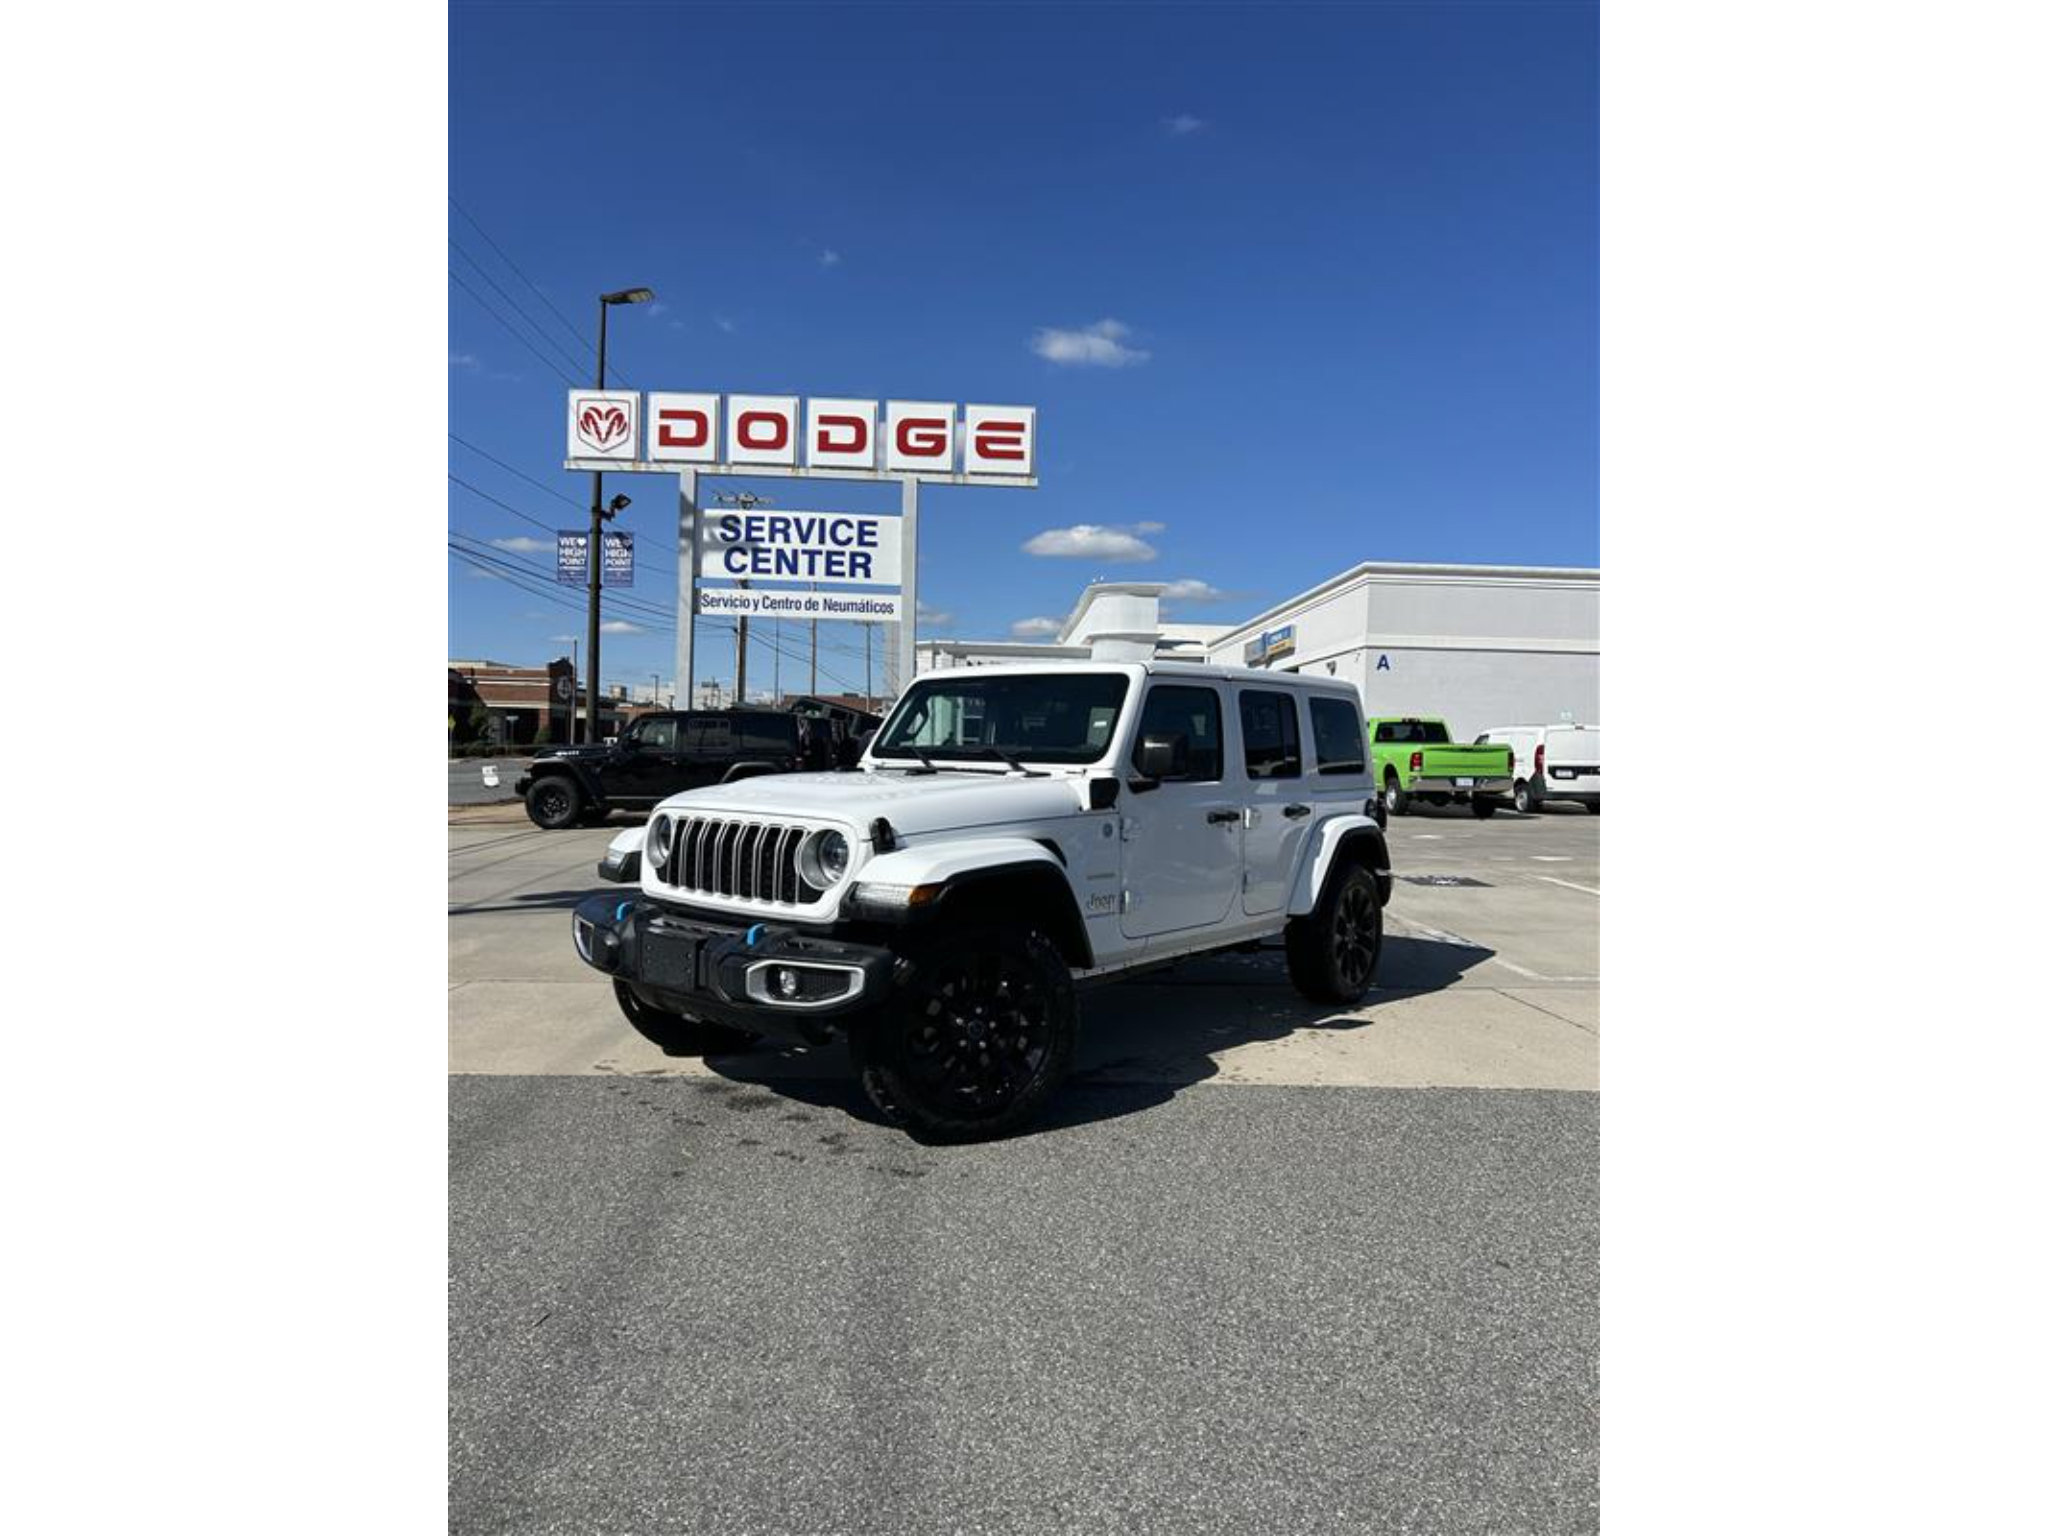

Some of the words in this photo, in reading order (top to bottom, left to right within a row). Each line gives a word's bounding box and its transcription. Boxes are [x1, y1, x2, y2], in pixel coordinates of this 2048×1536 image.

[658, 409, 1025, 459] DODGE
[720, 514, 878, 548] SERVICE
[559, 537, 577, 546] WE
[605, 538, 622, 548] WE
[559, 547, 587, 557] HIGH
[559, 557, 586, 566] POINT
[605, 558, 632, 567] POINT
[724, 546, 872, 579] CENTER
[701, 593, 750, 609] Servicio
[753, 597, 760, 612] y
[762, 594, 800, 611] Centro
[804, 596, 819, 612] de
[823, 598, 895, 615] Neumáticos
[1376, 654, 1390, 670] A
